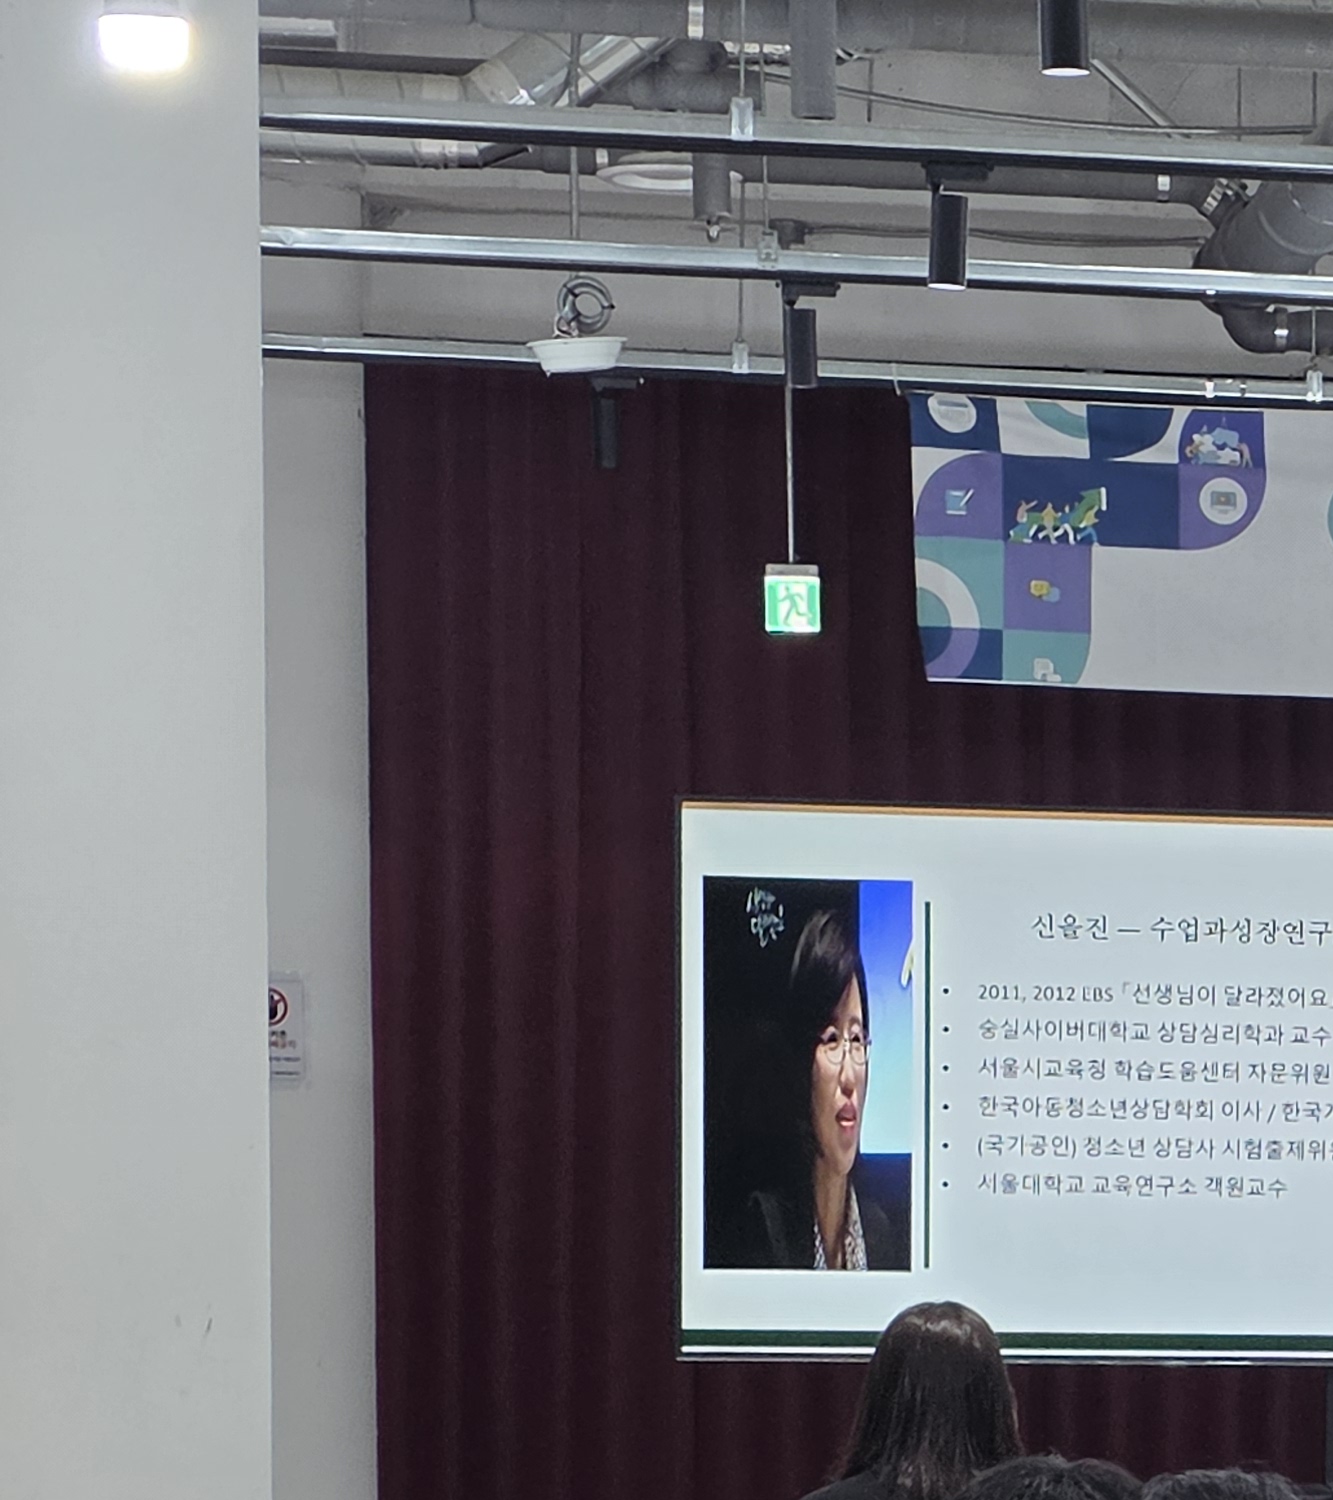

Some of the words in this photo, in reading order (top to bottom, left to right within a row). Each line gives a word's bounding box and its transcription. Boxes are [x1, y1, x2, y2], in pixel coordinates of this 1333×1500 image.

[1031, 913, 1109, 941] 신을진
[978, 984, 1027, 1004] 2011,
[1033, 985, 1076, 1002] 2012
[978, 1018, 1151, 1043] 숭실사이버대학교
[1157, 1021, 1285, 1046] 상담심리학과
[1289, 1026, 1333, 1048] 교수
[978, 1056, 1106, 1081] 서울시교육청
[1114, 1058, 1240, 1083] 학습도움센터
[1247, 1062, 1330, 1085] 자문위원
[978, 1095, 1214, 1122] 한국아동청소년상담학회
[1221, 1099, 1260, 1123] 이사
[1083, 1136, 1146, 1159] 청소년
[1153, 1137, 1215, 1160] 상담사
[977, 1172, 1085, 1196] 서울대학교
[1091, 1174, 1198, 1198] 교육연구소
[1204, 1176, 1288, 1199] 객원교수
